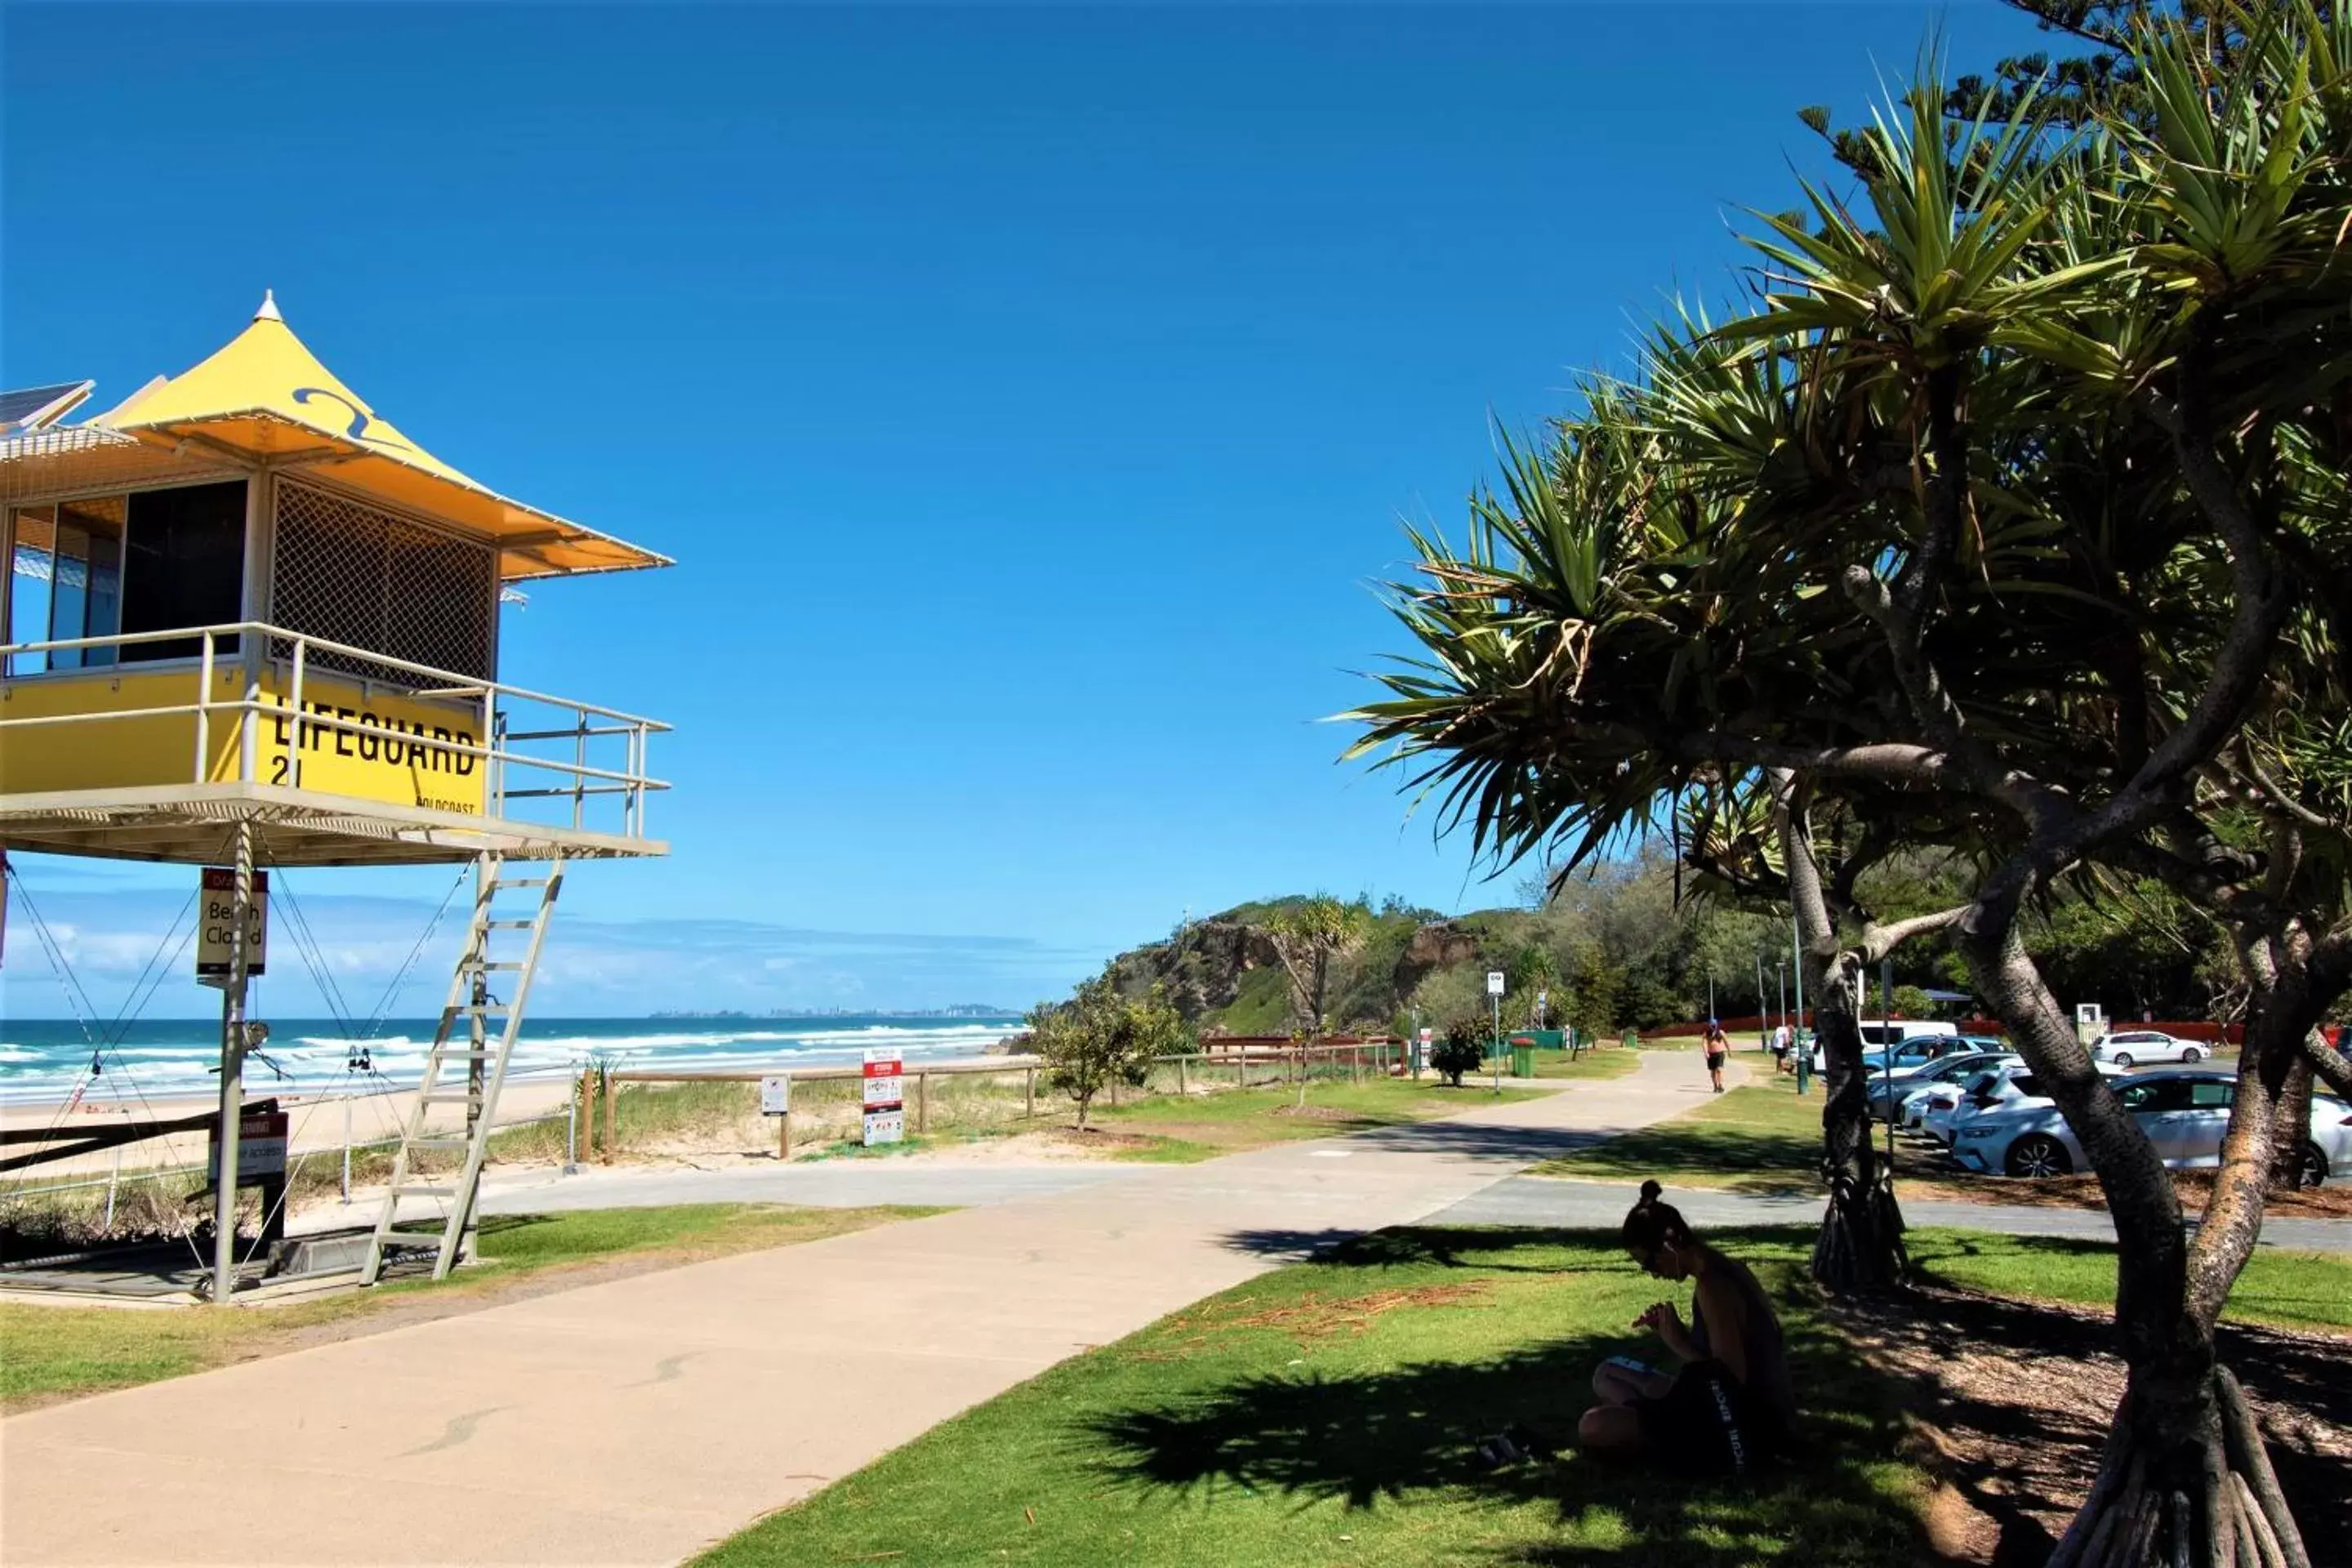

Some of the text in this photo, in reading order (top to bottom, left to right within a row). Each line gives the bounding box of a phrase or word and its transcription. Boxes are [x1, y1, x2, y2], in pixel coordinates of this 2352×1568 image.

[275, 696, 475, 776] LIFEGUARD
[271, 755, 301, 789] 21
[209, 902, 260, 920] Beh
[206, 926, 261, 945] Clod
